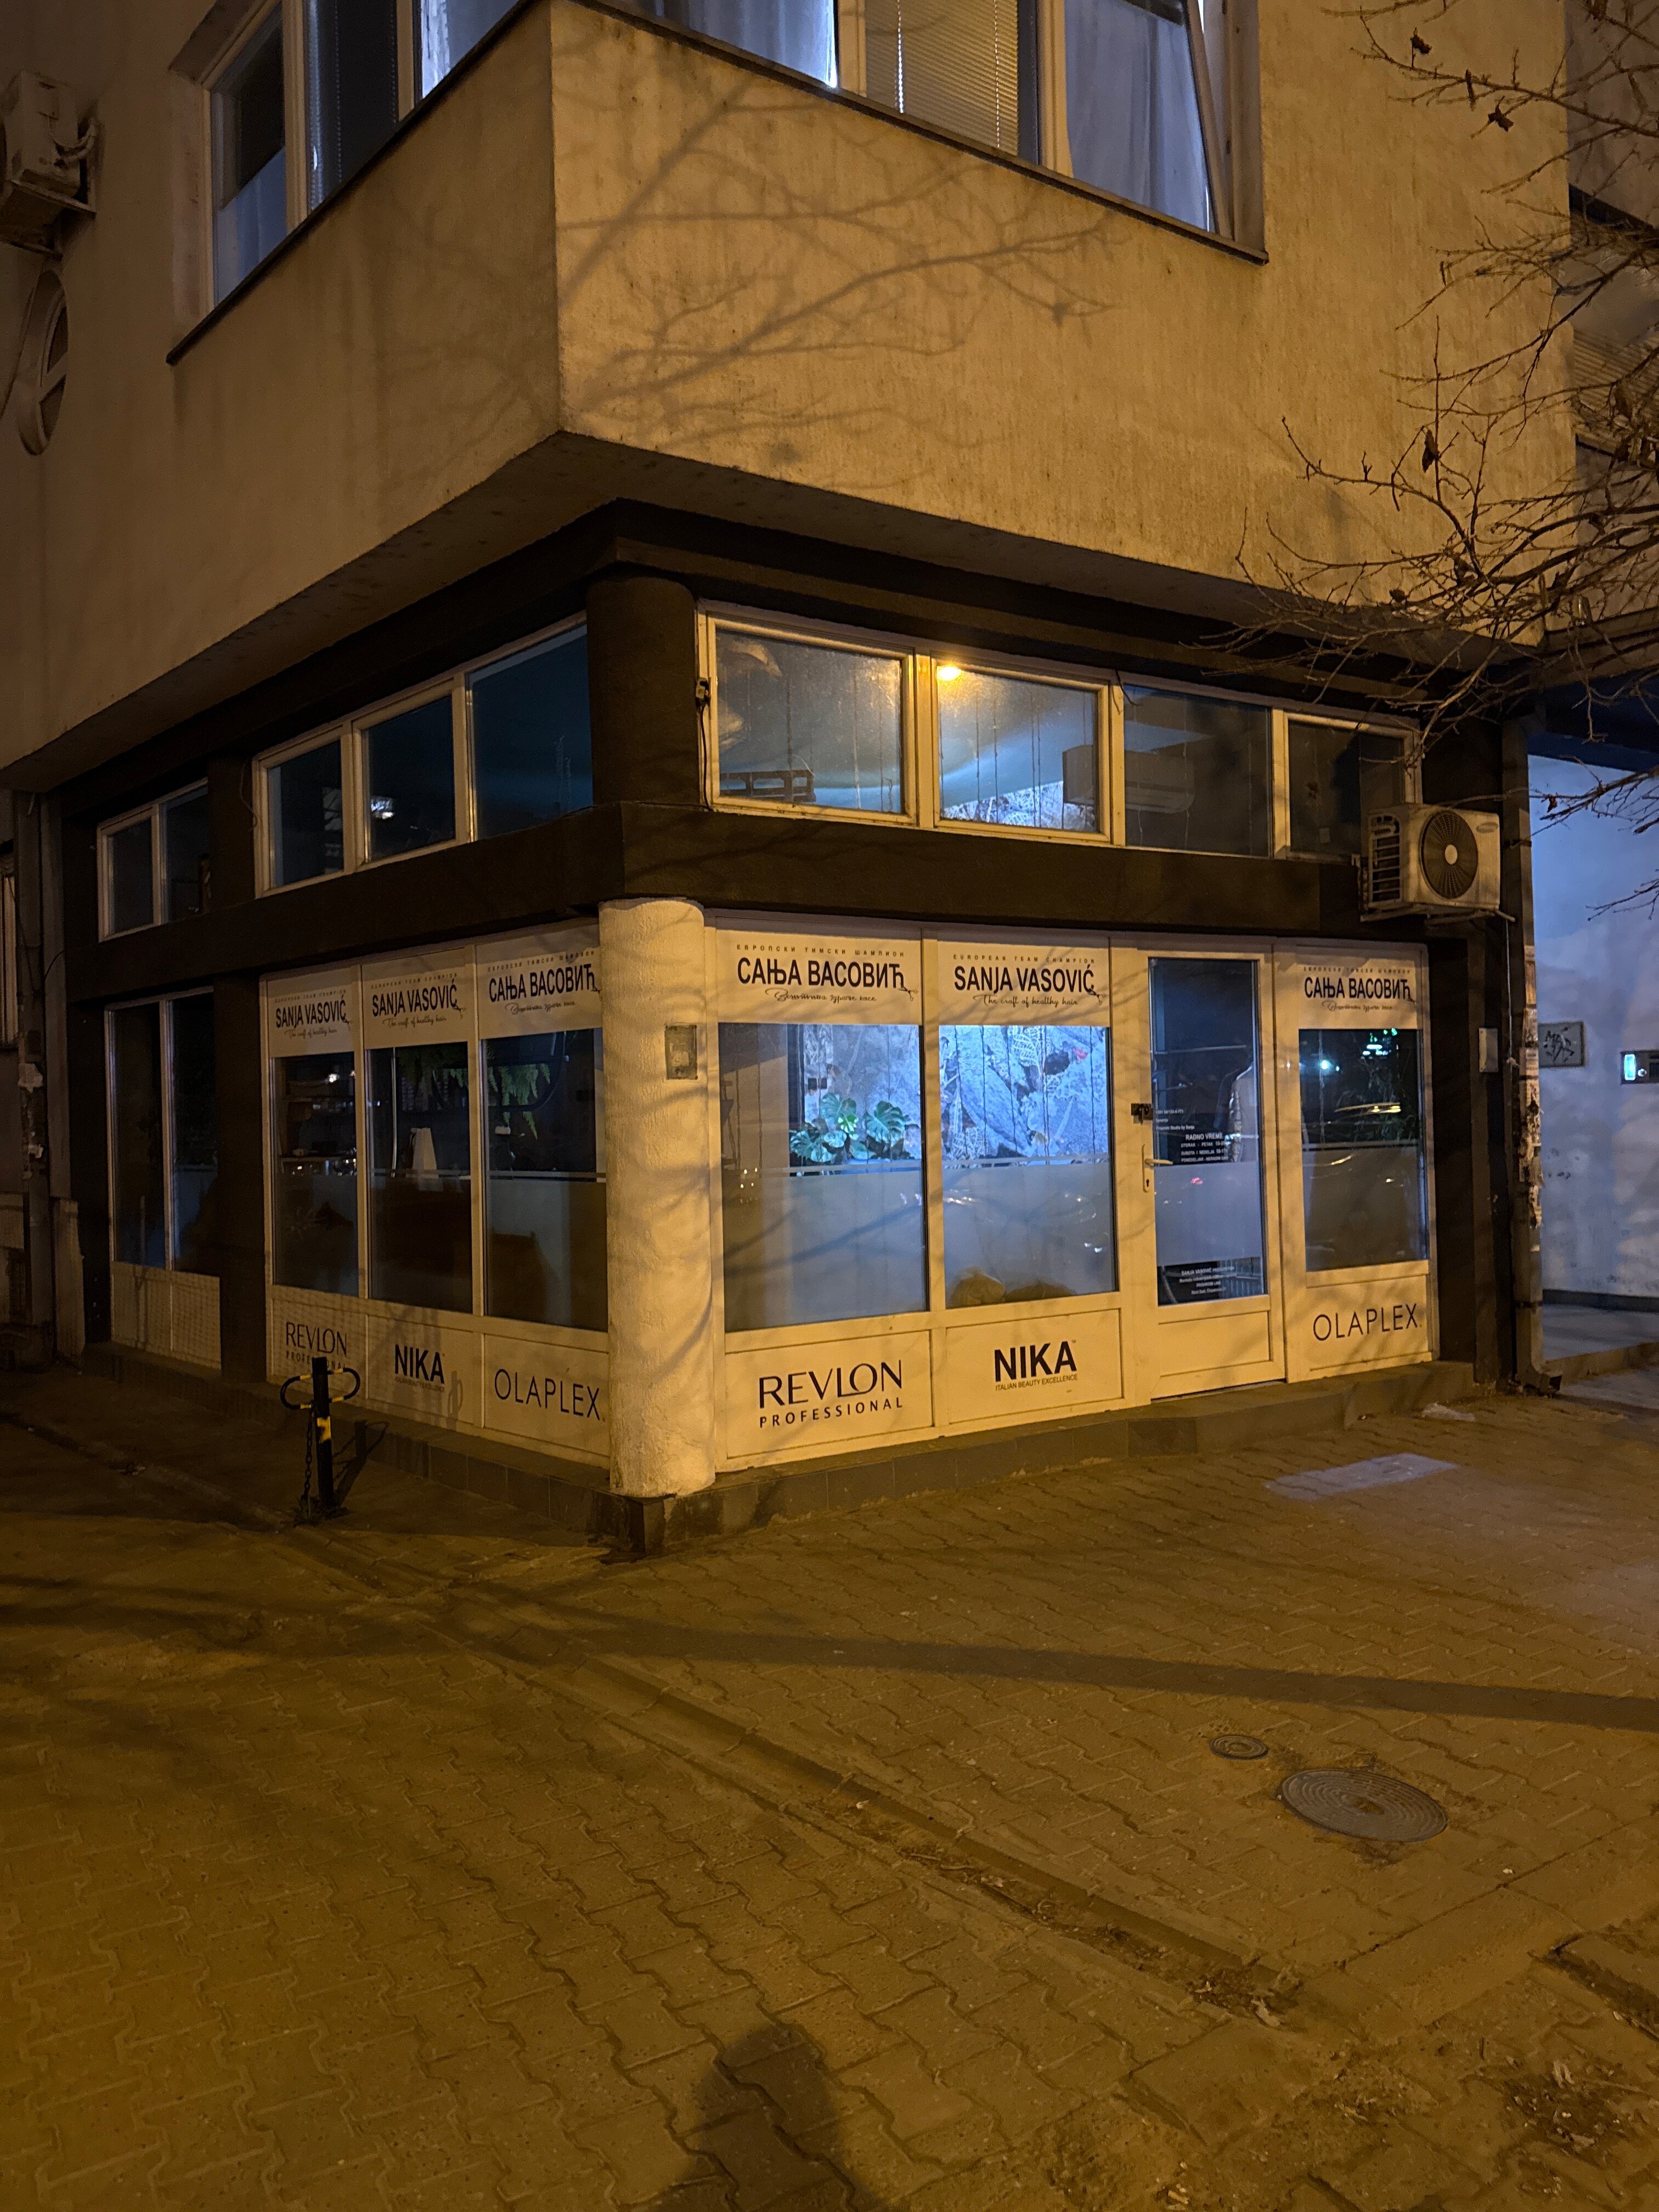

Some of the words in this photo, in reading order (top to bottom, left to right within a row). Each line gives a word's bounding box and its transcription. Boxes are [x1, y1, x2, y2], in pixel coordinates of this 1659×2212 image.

[737, 944, 795, 952] ЕВРОПСКИ
[489, 974, 527, 1002] САЊА
[530, 963, 595, 997] ВАСОВИЋ
[737, 957, 802, 986] САЊА
[808, 960, 905, 989] ВАСОВИЋ
[954, 966, 1013, 994] SANJA
[1016, 964, 1094, 993] VASOVIĆ
[1304, 977, 1345, 998] САЊА
[1348, 978, 1411, 1000] ВАСОВИЋ
[276, 1005, 303, 1028] SANJA
[304, 994, 346, 1024] VASOVIĆ
[373, 991, 405, 1017] SANJA
[407, 978, 457, 1012] VASOVIĆ
[973, 994, 998, 1006] The
[1000, 996, 1019, 1008] craft
[1021, 996, 1029, 1008] of
[1031, 996, 1059, 1008] healthy
[1062, 996, 1078, 1005] hair
[286, 1322, 347, 1357] REVLON
[395, 1344, 444, 1384] NIKA
[995, 1341, 1077, 1382] NIKA
[759, 1359, 902, 1409] REVLON
[996, 1383, 1017, 1391] ITALIAN
[1018, 1379, 1041, 1387] BEAUTY
[1042, 1374, 1078, 1385] EXCELLENCE
[759, 1397, 902, 1428] PROFESSIONAL
